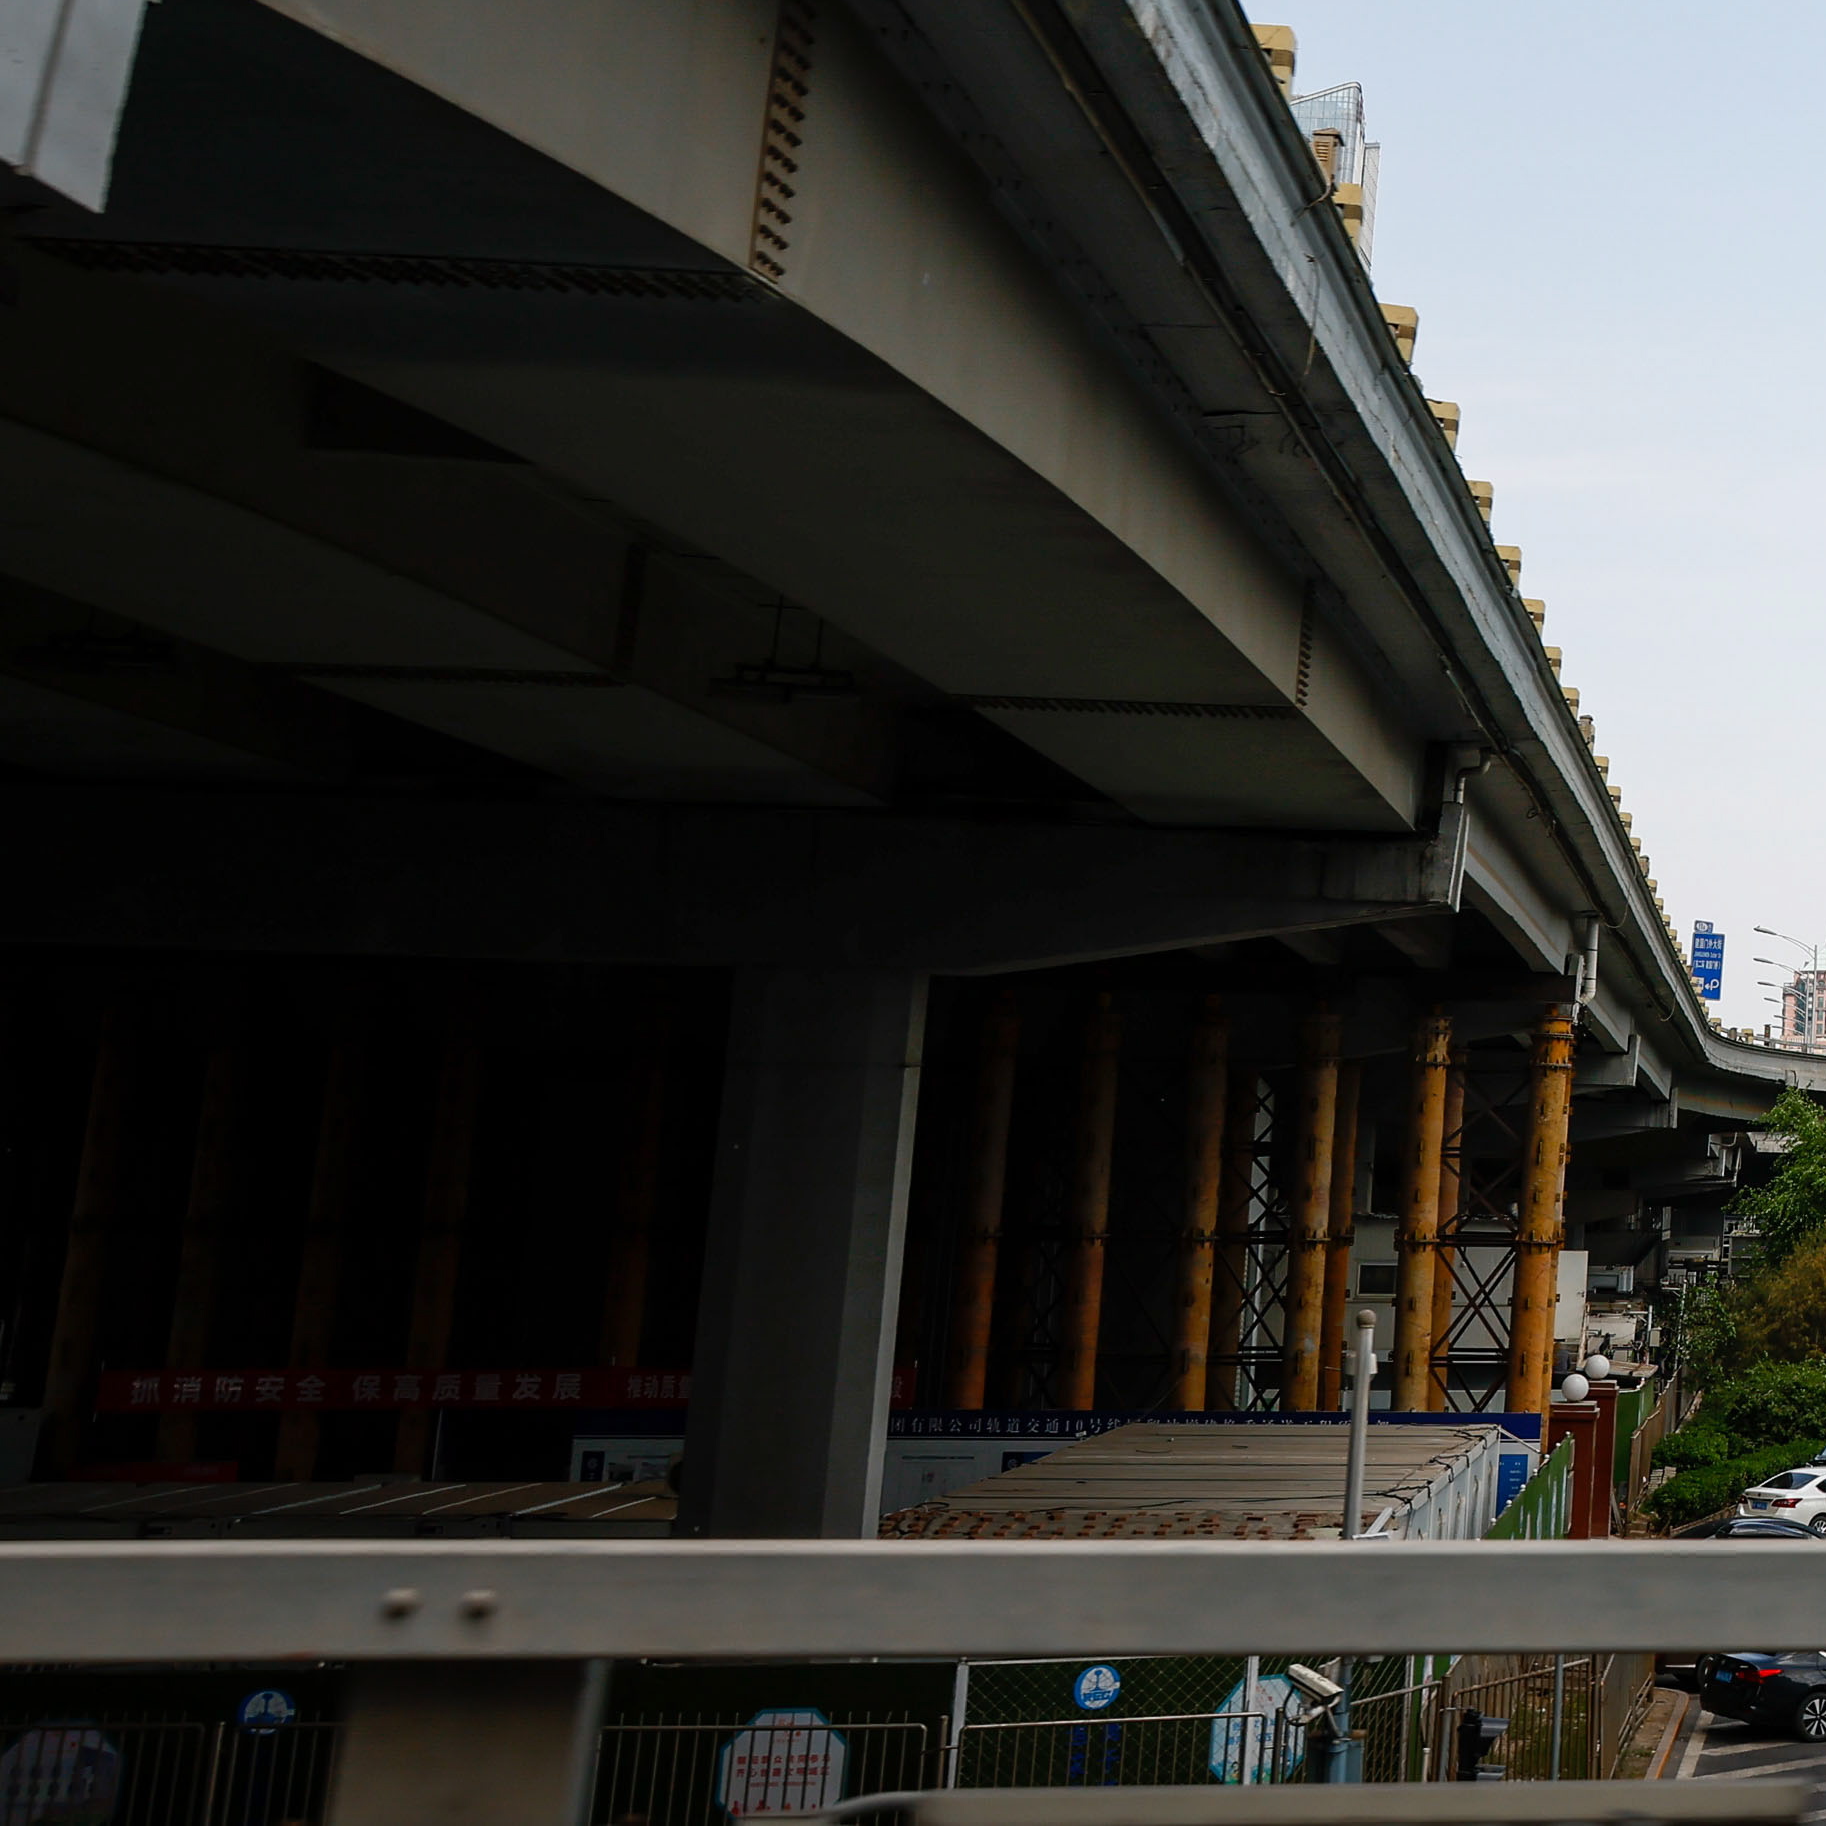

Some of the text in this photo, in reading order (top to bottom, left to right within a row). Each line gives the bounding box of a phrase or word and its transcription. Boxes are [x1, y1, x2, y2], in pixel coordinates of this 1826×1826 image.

[129, 1374, 327, 1405] 抓消防安全
[351, 1373, 585, 1403] 保高质量发展
